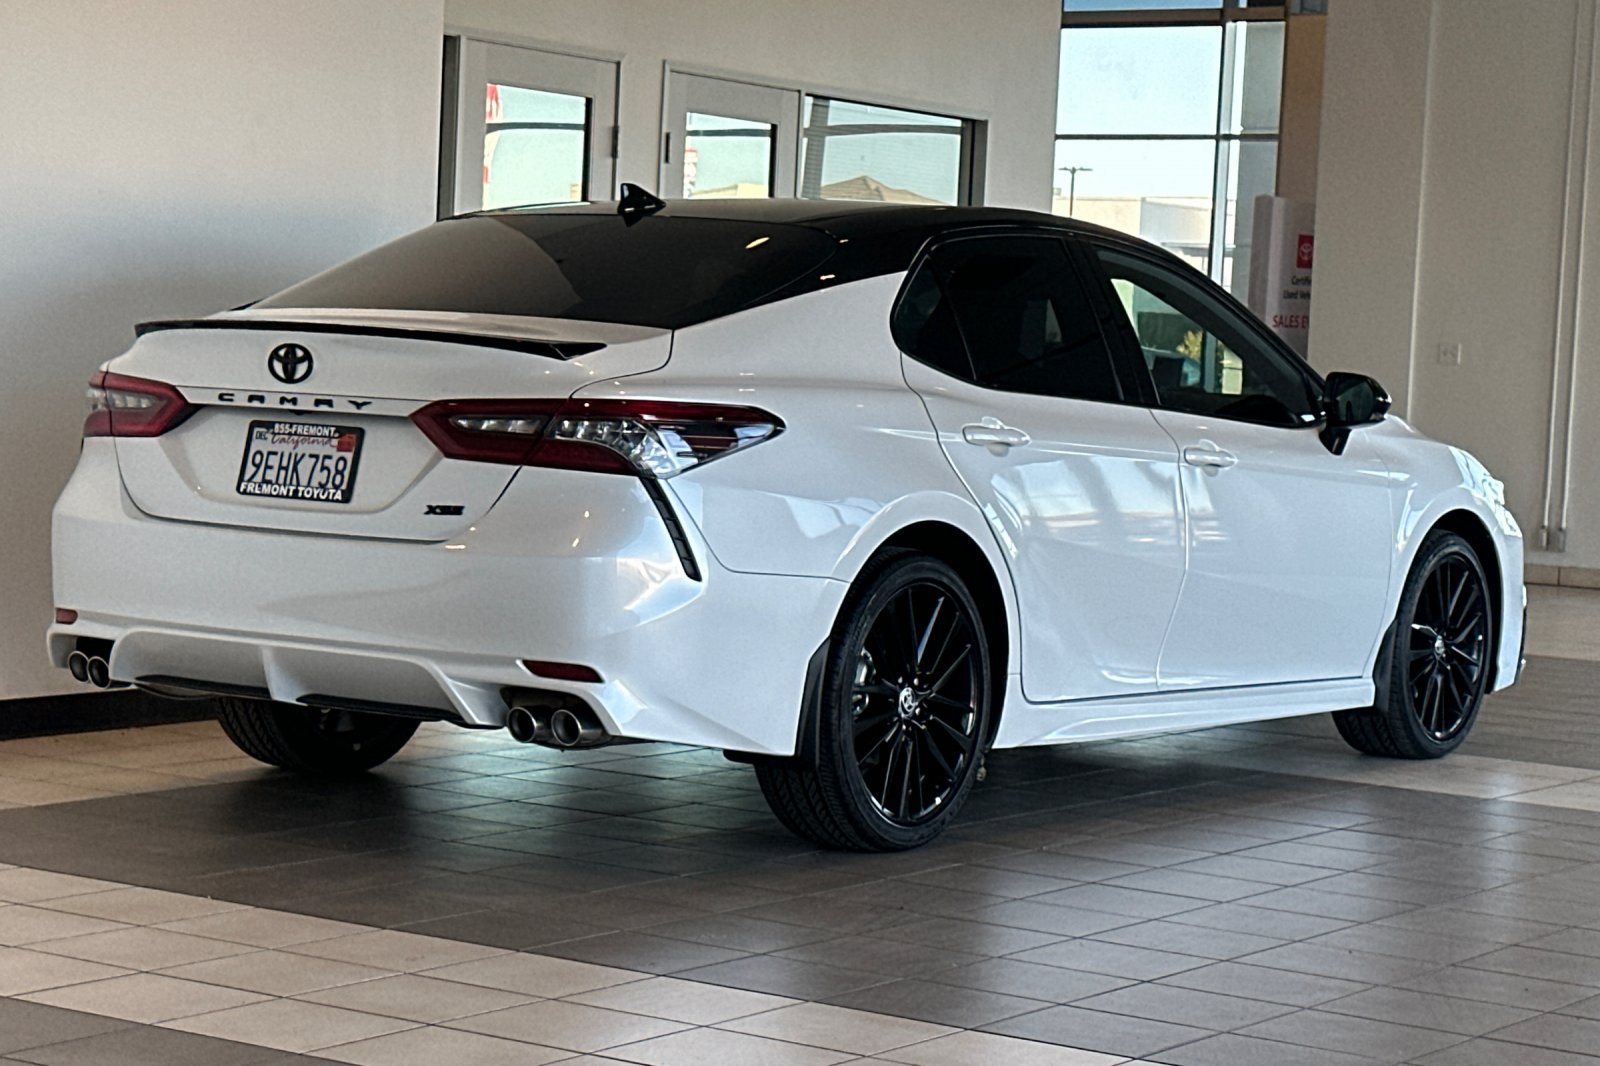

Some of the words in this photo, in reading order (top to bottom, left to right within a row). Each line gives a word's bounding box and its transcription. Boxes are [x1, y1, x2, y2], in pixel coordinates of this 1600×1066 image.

[1272, 315, 1299, 329] SALES
[218, 393, 372, 410] CAMRY
[271, 434, 337, 450] California
[247, 450, 347, 489] 9EHK758
[240, 482, 296, 497] FREMONT
[298, 486, 342, 500] TOYOTA
